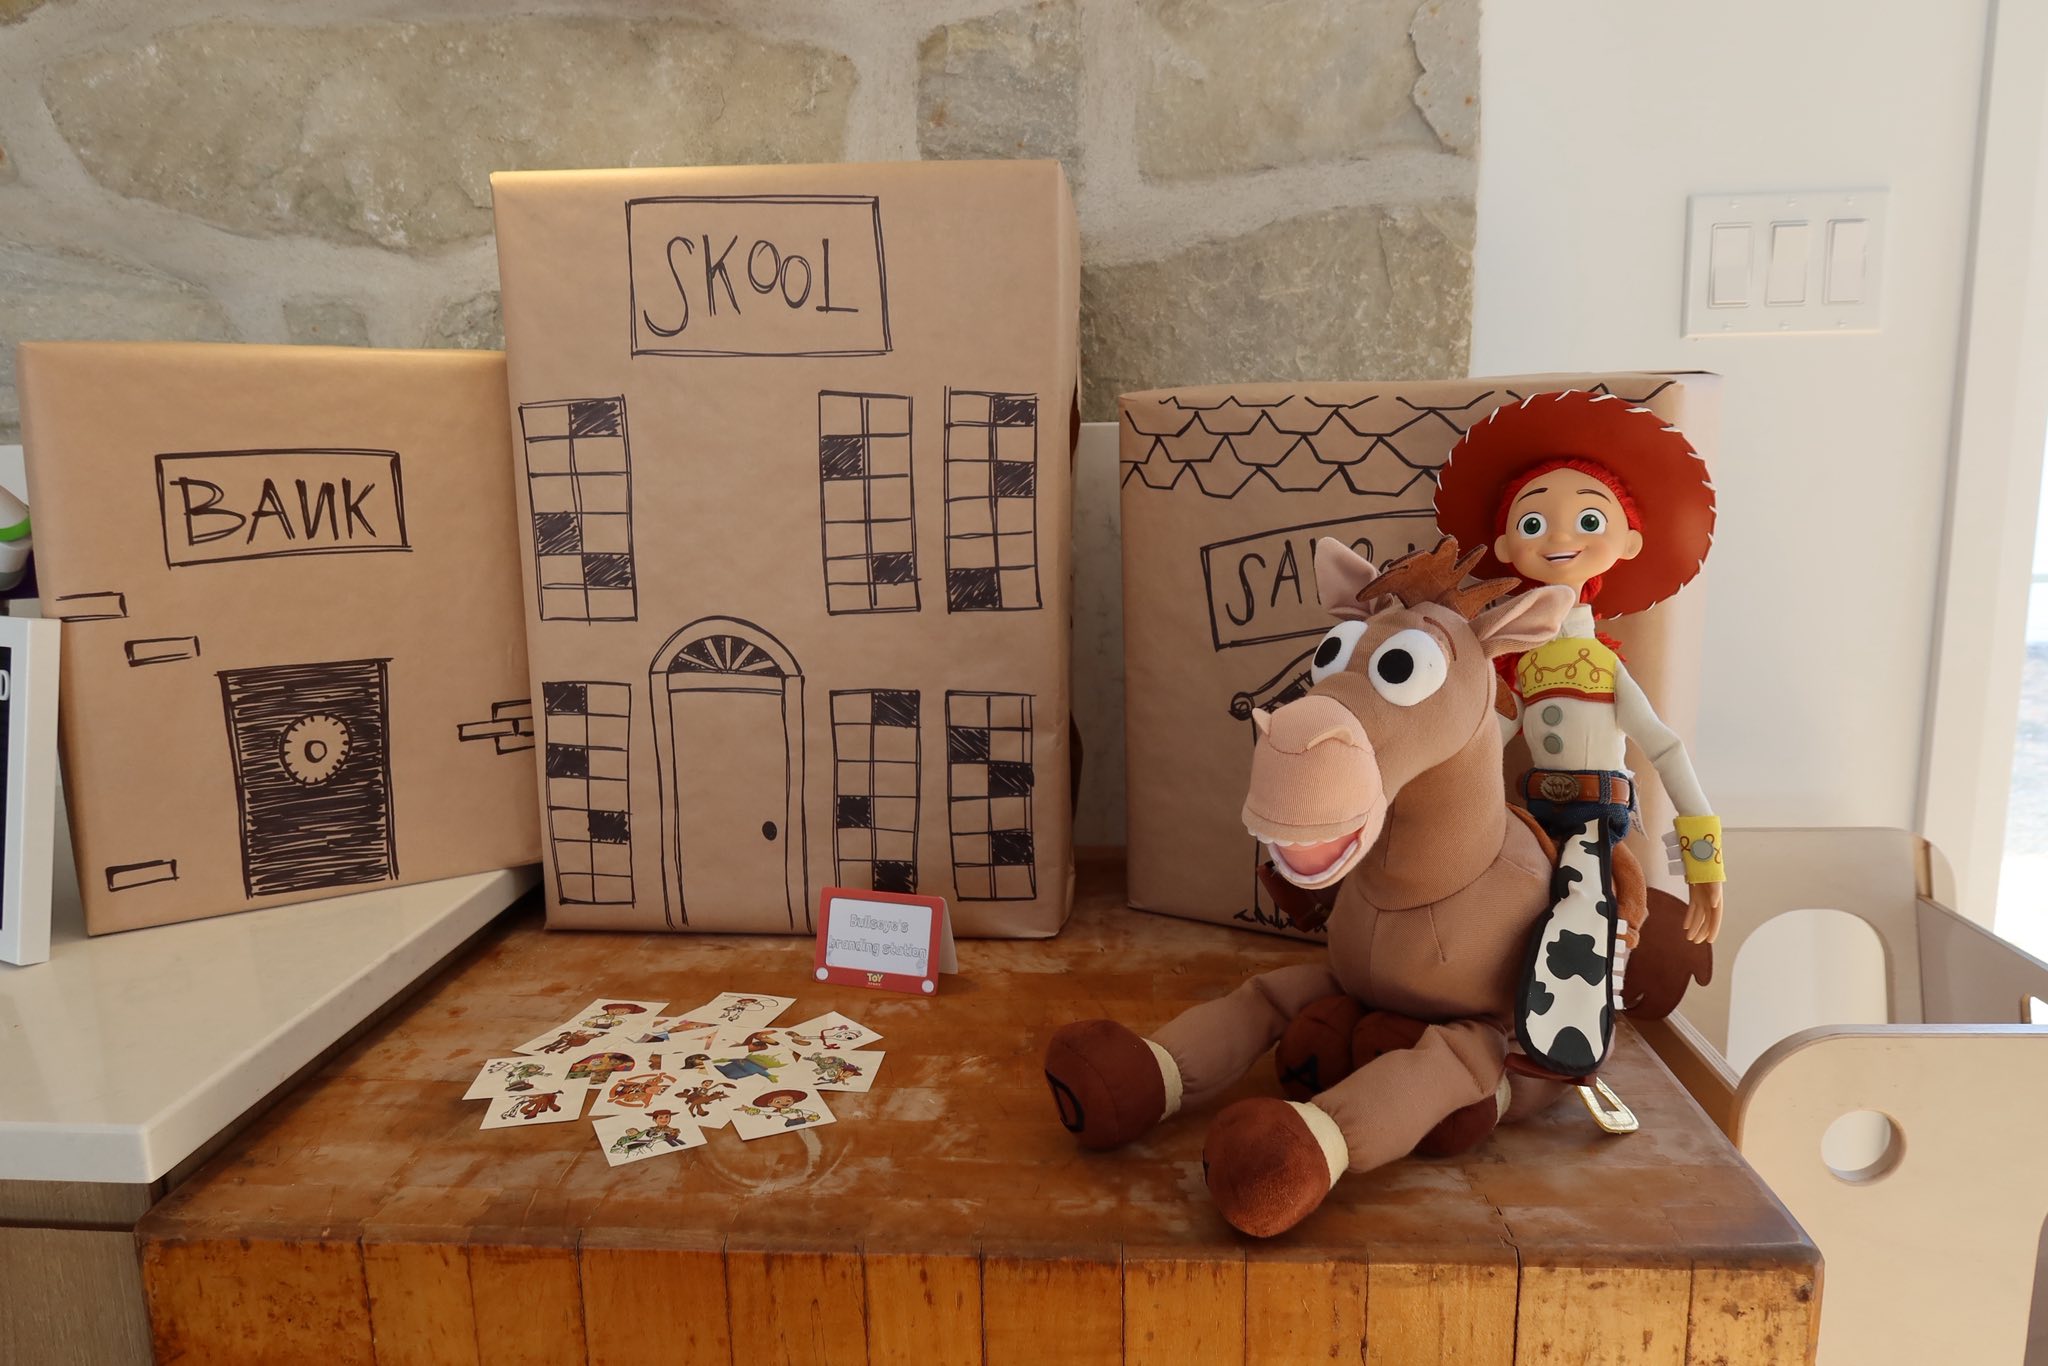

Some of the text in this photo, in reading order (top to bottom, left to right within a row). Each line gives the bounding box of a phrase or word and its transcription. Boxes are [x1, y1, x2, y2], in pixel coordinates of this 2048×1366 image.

[643, 234, 859, 337] SKOOL
[849, 913, 909, 934] Bullseye's
[881, 942, 927, 959] station
